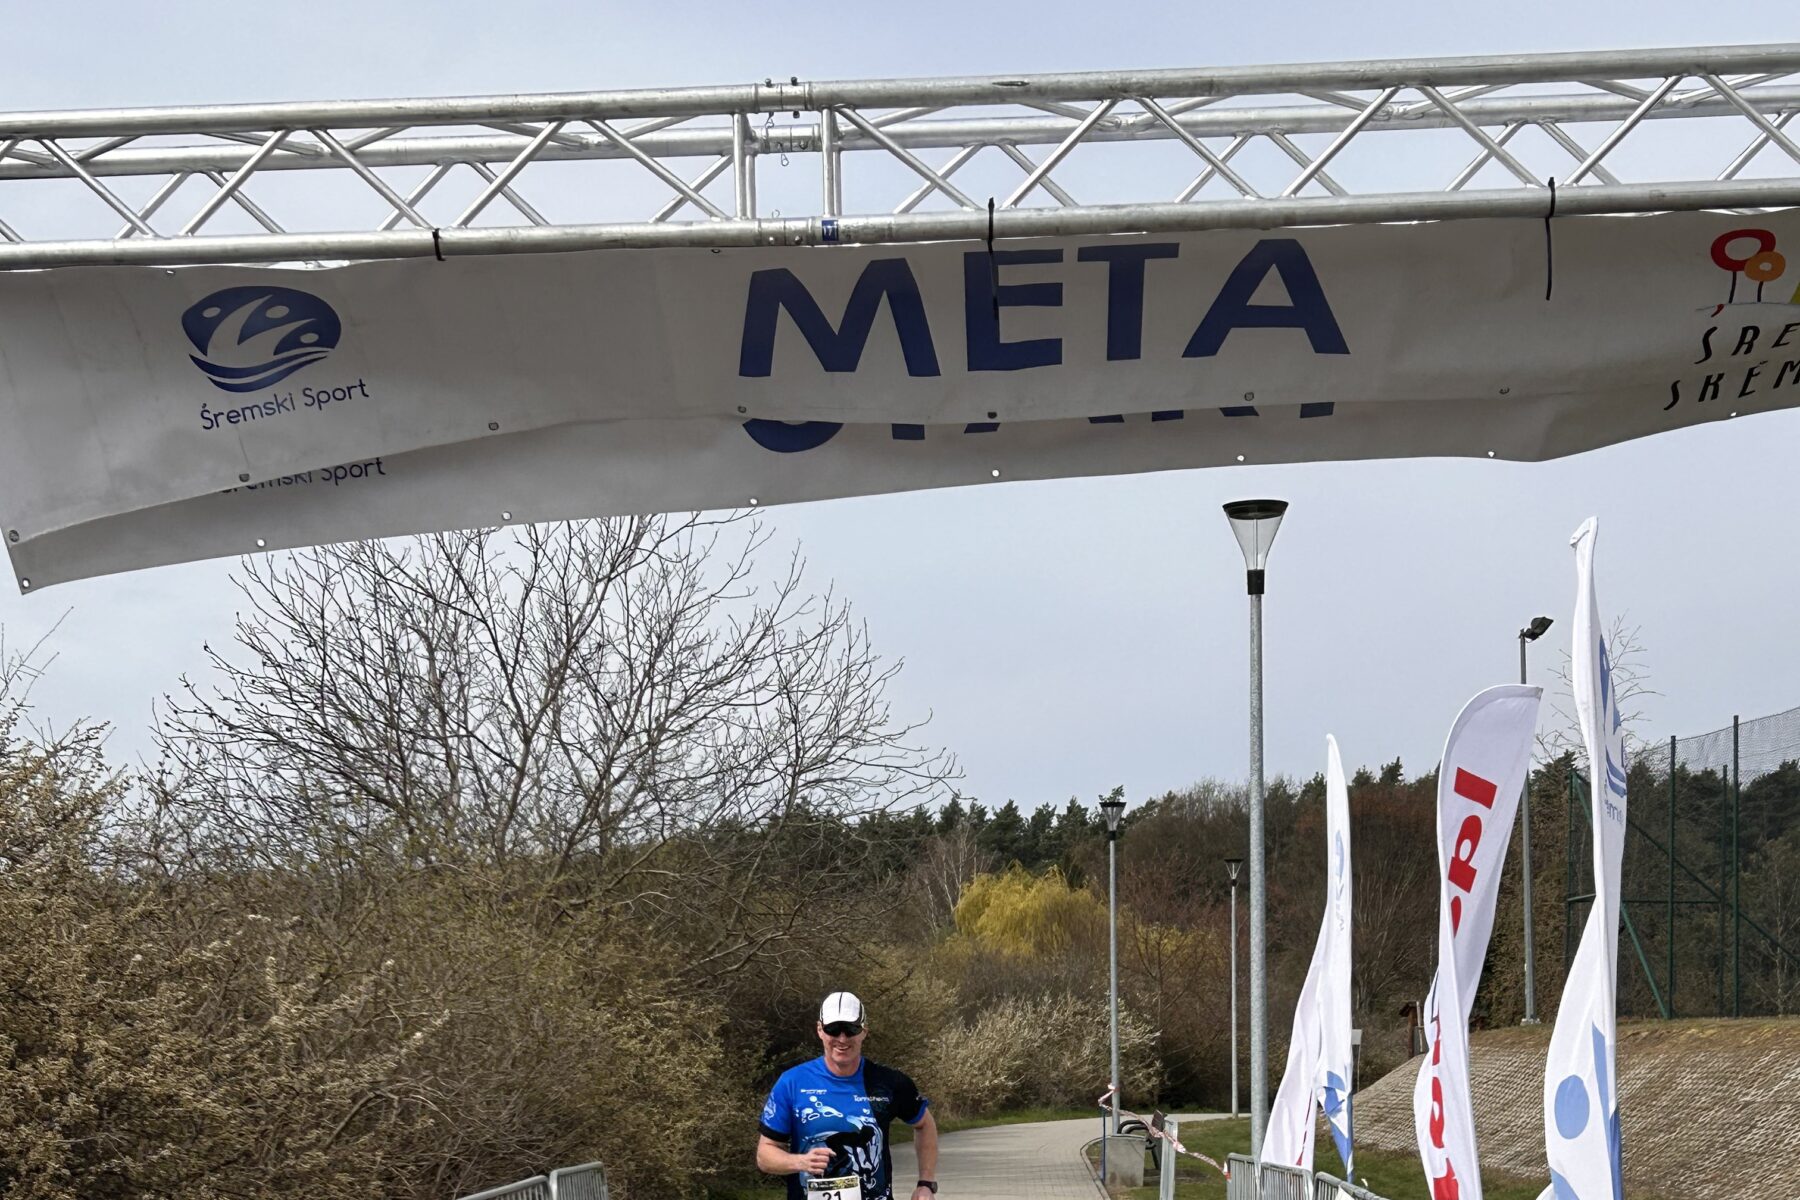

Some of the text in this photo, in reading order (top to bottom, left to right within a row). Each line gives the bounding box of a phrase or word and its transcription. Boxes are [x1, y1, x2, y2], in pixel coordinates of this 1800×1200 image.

[739, 239, 1350, 377] META
[200, 378, 370, 430] Śremski Sport
